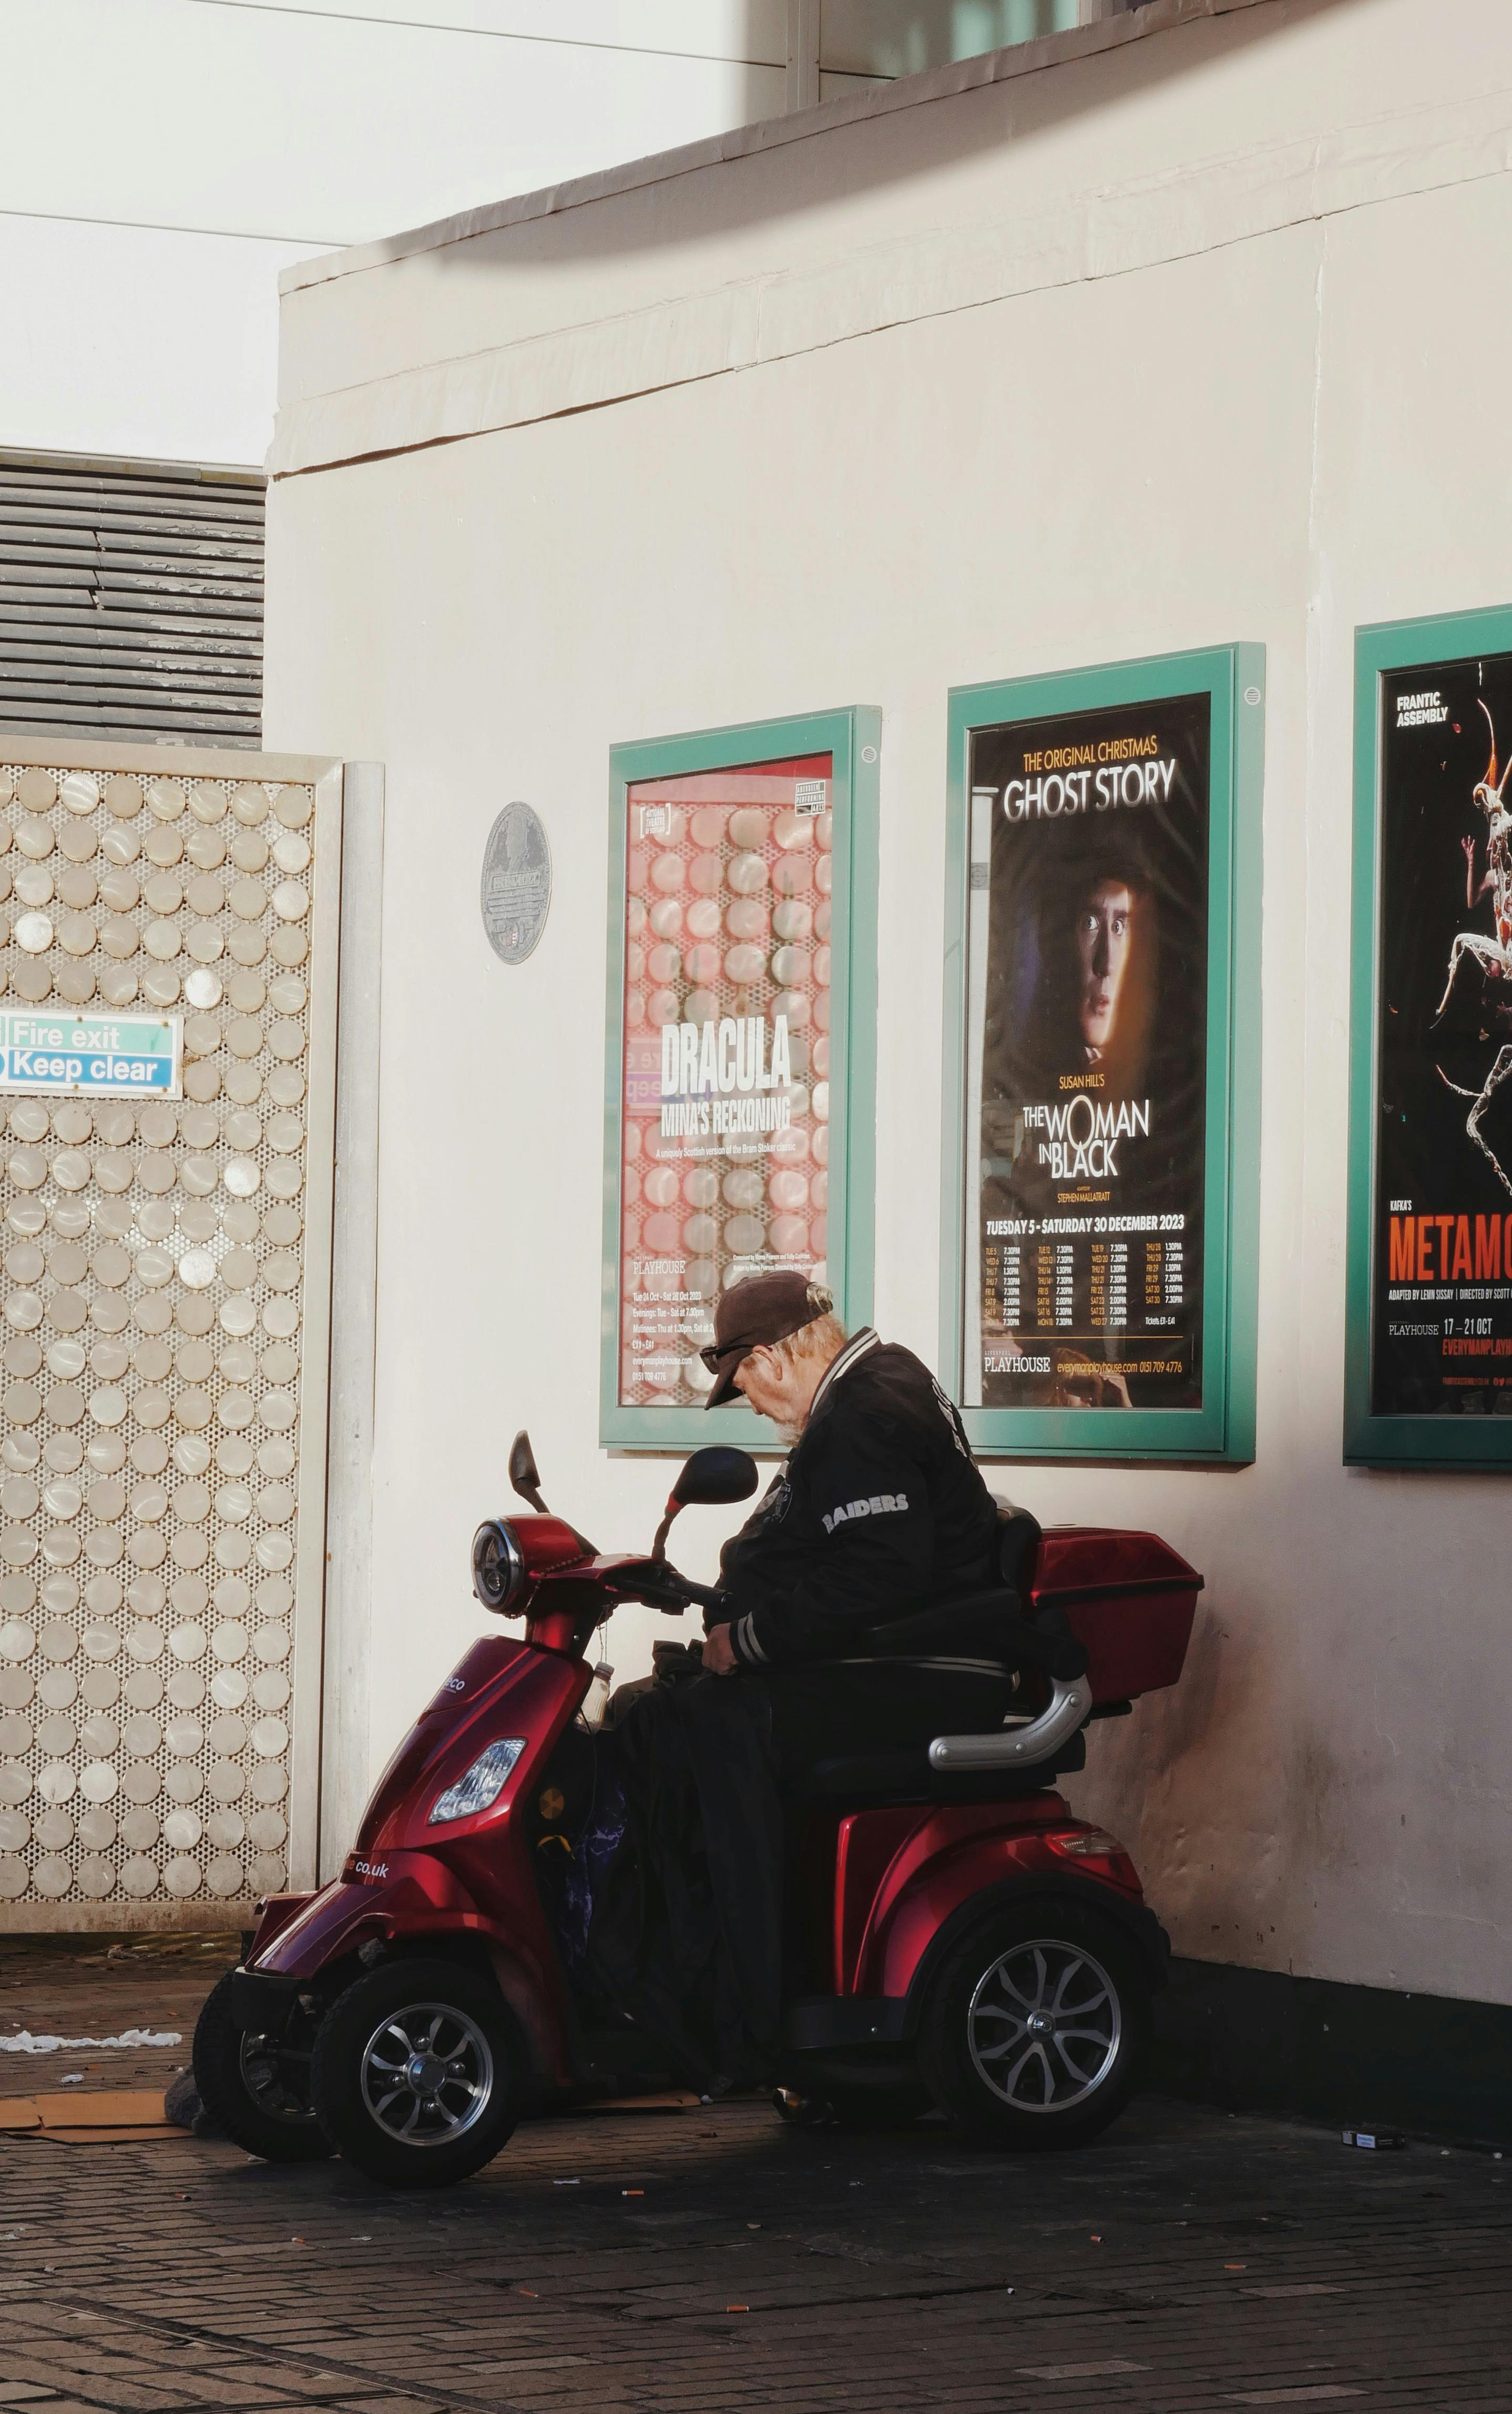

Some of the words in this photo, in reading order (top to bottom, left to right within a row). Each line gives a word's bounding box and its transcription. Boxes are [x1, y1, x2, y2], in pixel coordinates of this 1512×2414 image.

[1397, 692, 1440, 711] FRANTIC
[1397, 707, 1448, 727] ASSEMBLY
[1024, 751, 1041, 772] THE
[1045, 744, 1096, 769] ORIGINAL
[1098, 735, 1157, 762] CHRISTMAS
[1004, 771, 1090, 823] GHOST
[1095, 759, 1176, 812] STORY
[14, 1021, 63, 1046] Fire
[71, 1026, 120, 1049] exit
[662, 1015, 791, 1095] DRACULA
[14, 1051, 82, 1082] Keep
[91, 1056, 157, 1081] clear
[1059, 1076, 1084, 1089] SUSAN
[1086, 1074, 1105, 1087] HILL'S
[662, 1101, 709, 1137] MINA'S
[713, 1097, 791, 1134] RECKONING
[1023, 1106, 1044, 1128] THE
[1045, 1095, 1149, 1151] WOMAN
[656, 1149, 660, 1158] A
[661, 1148, 683, 1159] uniquely
[683, 1147, 705, 1157] Scottish
[706, 1145, 725, 1155] version
[726, 1145, 732, 1154] of
[733, 1144, 741, 1154] the
[742, 1144, 757, 1153] Bram
[758, 1143, 775, 1152] Stoker
[777, 1142, 796, 1152] classic
[1039, 1143, 1052, 1164] IN
[1051, 1139, 1118, 1179] BLACK
[1057, 1193, 1079, 1203] STEPHEN
[1080, 1192, 1110, 1202] MALLATRATT
[1390, 1200, 1412, 1211] KAFKA'S
[987, 1220, 1028, 1235] TUESDAY
[1029, 1221, 1035, 1234] 5
[1041, 1218, 1092, 1233] SATURDAY
[1094, 1218, 1106, 1232] 30
[1108, 1215, 1158, 1232] DECEMBER
[1159, 1214, 1184, 1230] 2023
[1165, 1242, 1182, 1251] 1.30PM
[634, 1261, 686, 1274] PLAYHOUSE
[633, 1293, 642, 1301] Tue
[650, 1292, 659, 1301] Oct
[680, 1292, 688, 1301] Oct
[690, 1292, 701, 1301] 2023
[1388, 1290, 1411, 1301] ADAPTED
[1413, 1290, 1419, 1300] BY
[1421, 1290, 1435, 1300] LEMN
[1436, 1289, 1454, 1300] SISSAY
[1460, 1288, 1484, 1300] DIRECTED
[1485, 1288, 1492, 1299] BY
[1493, 1288, 1509, 1299] SCOTT
[633, 1308, 656, 1318] Evenings:
[657, 1308, 667, 1317] Tue
[670, 1308, 679, 1317] Sat
[686, 1307, 704, 1318] 7.30pm
[633, 1324, 656, 1333] Matinees:
[658, 1324, 667, 1333] Thu
[668, 1324, 673, 1333] at
[694, 1324, 703, 1333] Sat
[1389, 1325, 1439, 1335] PLAYHOUSE
[1444, 1318, 1454, 1334] 17
[1465, 1318, 1474, 1334] 21
[1477, 1318, 1493, 1334] OCT
[632, 1340, 641, 1349] £11
[646, 1339, 654, 1349] £41
[984, 1357, 1050, 1373] PLAYHOUSE
[1057, 1362, 1137, 1376] everymanplayhouse.com
[1139, 1362, 1151, 1373] 0151
[1152, 1362, 1164, 1373] 709
[1166, 1362, 1182, 1373] 4776
[632, 1372, 643, 1381] 0151
